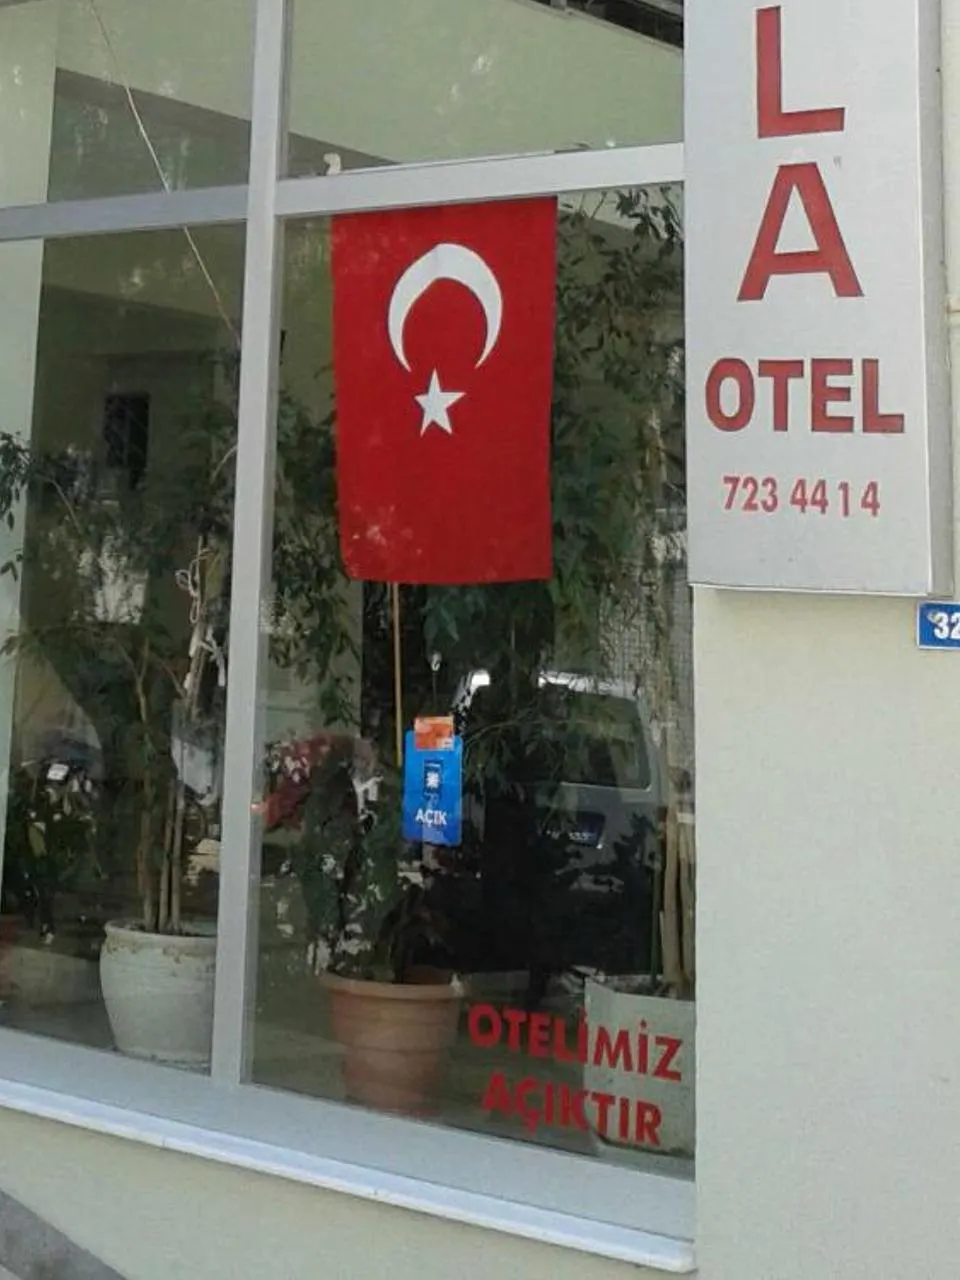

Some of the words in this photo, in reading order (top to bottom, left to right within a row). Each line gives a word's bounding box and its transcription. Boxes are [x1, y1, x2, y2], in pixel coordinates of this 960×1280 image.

[704, 357, 905, 433] OTEL
[723, 475, 778, 513] 723
[415, 807, 448, 828] AÇIK
[467, 1002, 683, 1082] OTELİMİZ
[481, 1072, 663, 1147] AÇIKTIR
